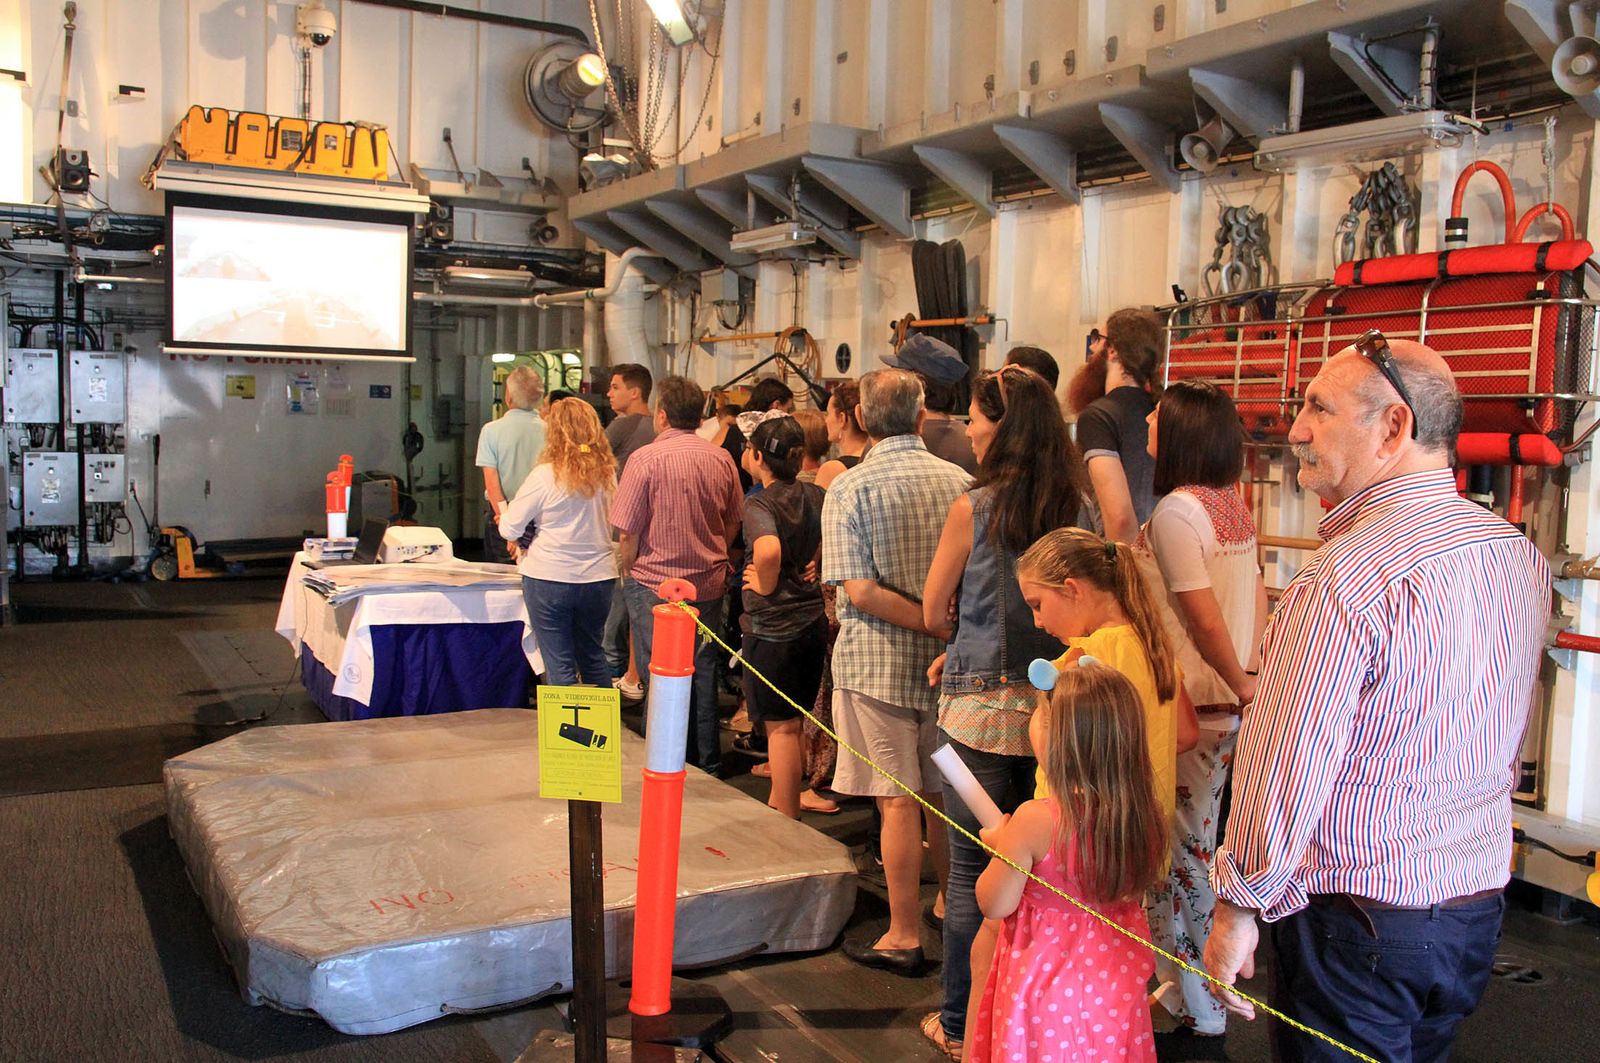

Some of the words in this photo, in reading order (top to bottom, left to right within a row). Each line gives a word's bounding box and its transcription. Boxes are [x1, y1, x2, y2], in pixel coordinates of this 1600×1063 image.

[543, 692, 561, 700] ZONA
[564, 693, 616, 702] VIDEOVIGILADA
[369, 887, 454, 914] NO
